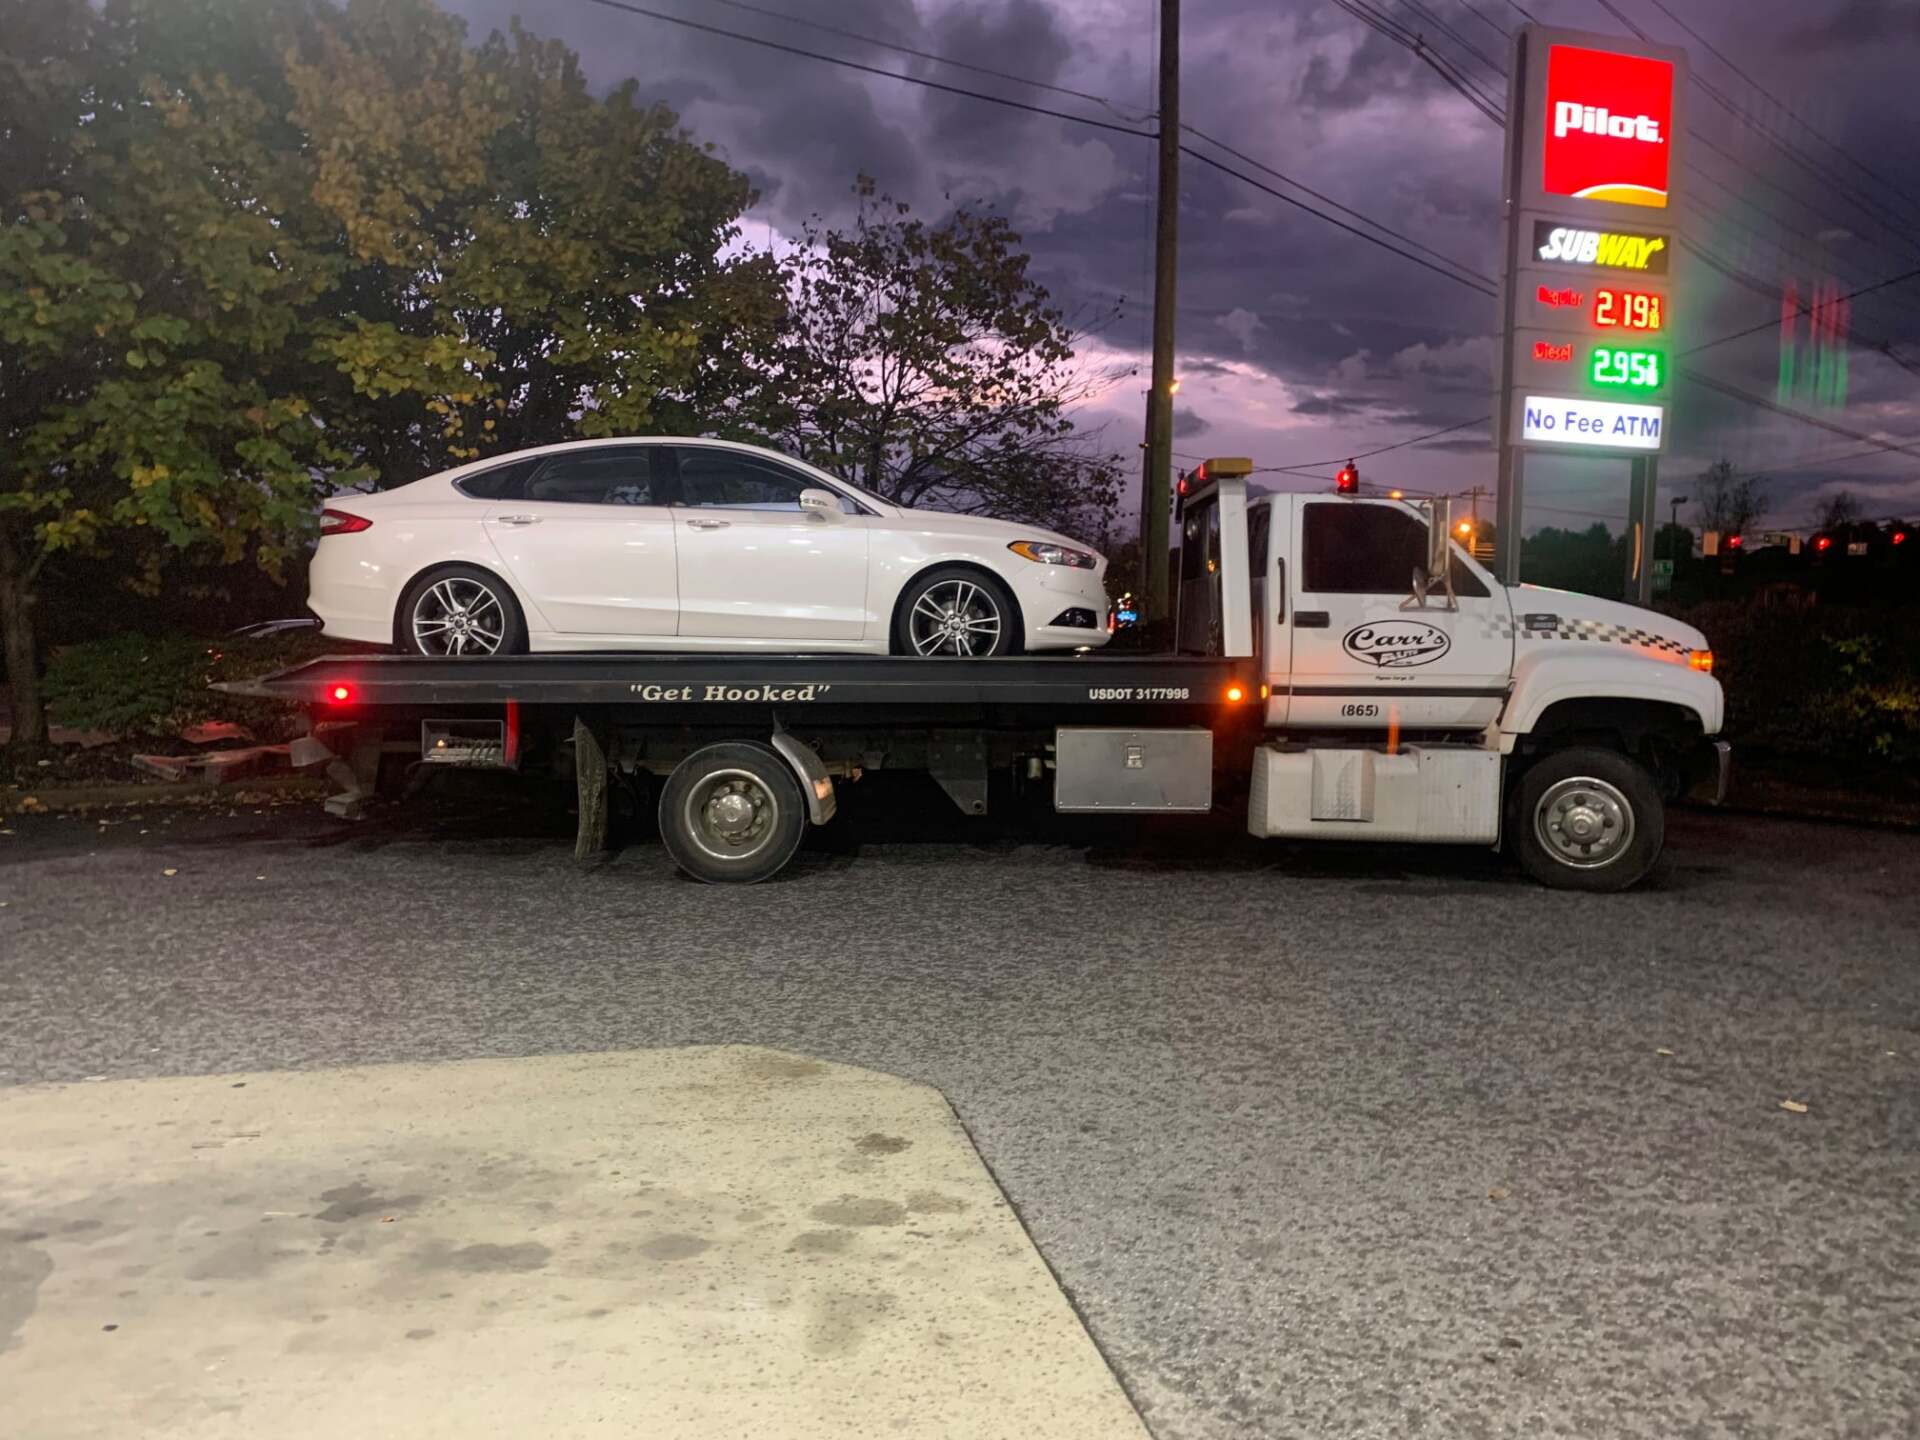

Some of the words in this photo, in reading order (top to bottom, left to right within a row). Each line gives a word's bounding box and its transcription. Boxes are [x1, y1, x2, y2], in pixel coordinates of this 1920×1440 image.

[1554, 101, 1660, 143] Pilot
[1539, 228, 1664, 269] SUBWAY
[1534, 342, 1572, 361] Diesel
[1526, 408, 1556, 430] No
[1565, 411, 1604, 433] Fee
[1612, 415, 1660, 438] ATM
[1348, 628, 1448, 651] Carr's
[1089, 688, 1133, 700] USDOT
[1136, 688, 1190, 700] 3177998
[1341, 704, 1379, 717] (865)
